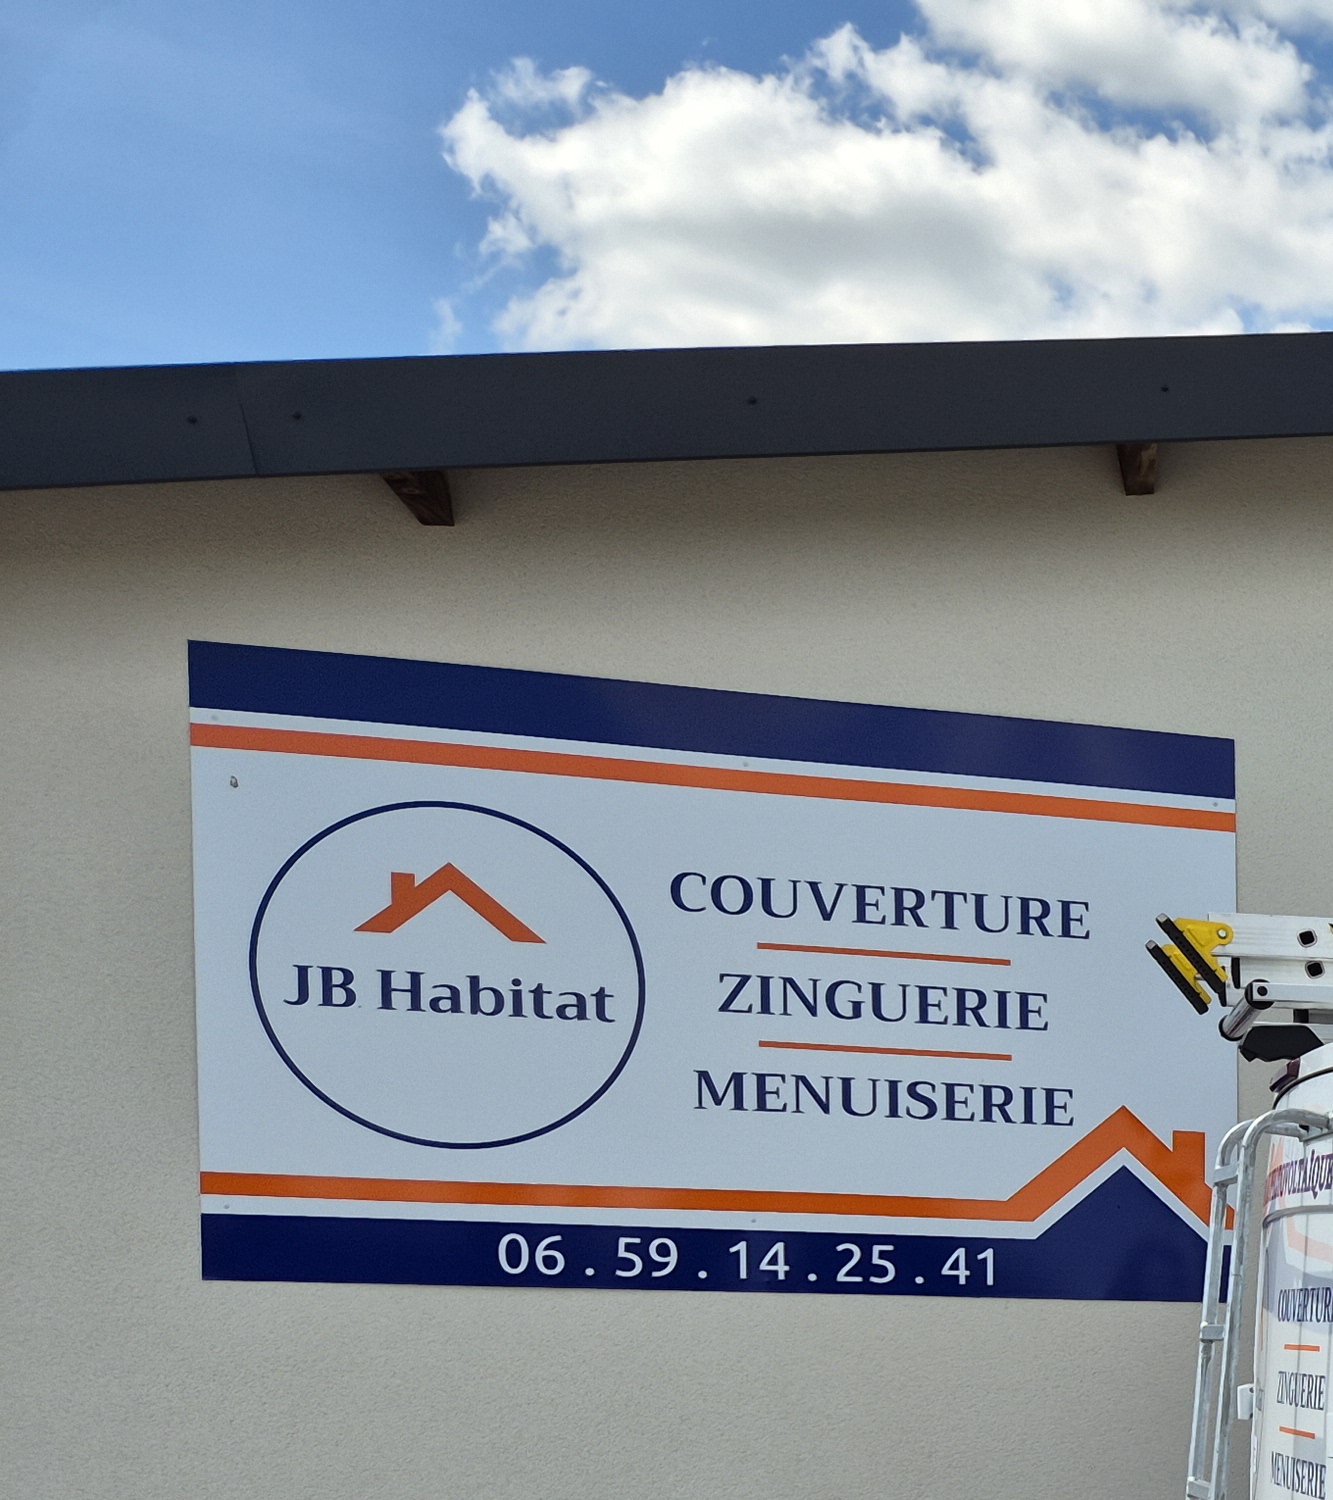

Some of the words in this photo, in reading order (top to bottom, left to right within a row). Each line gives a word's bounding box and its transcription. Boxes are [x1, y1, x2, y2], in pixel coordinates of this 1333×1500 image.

[669, 870, 1092, 941] COUVERTURE
[282, 963, 358, 1010] JB
[375, 968, 617, 1024] Habitat
[717, 972, 1050, 1032] ZINGUERIE
[692, 1068, 1075, 1128] MENUISERIE
